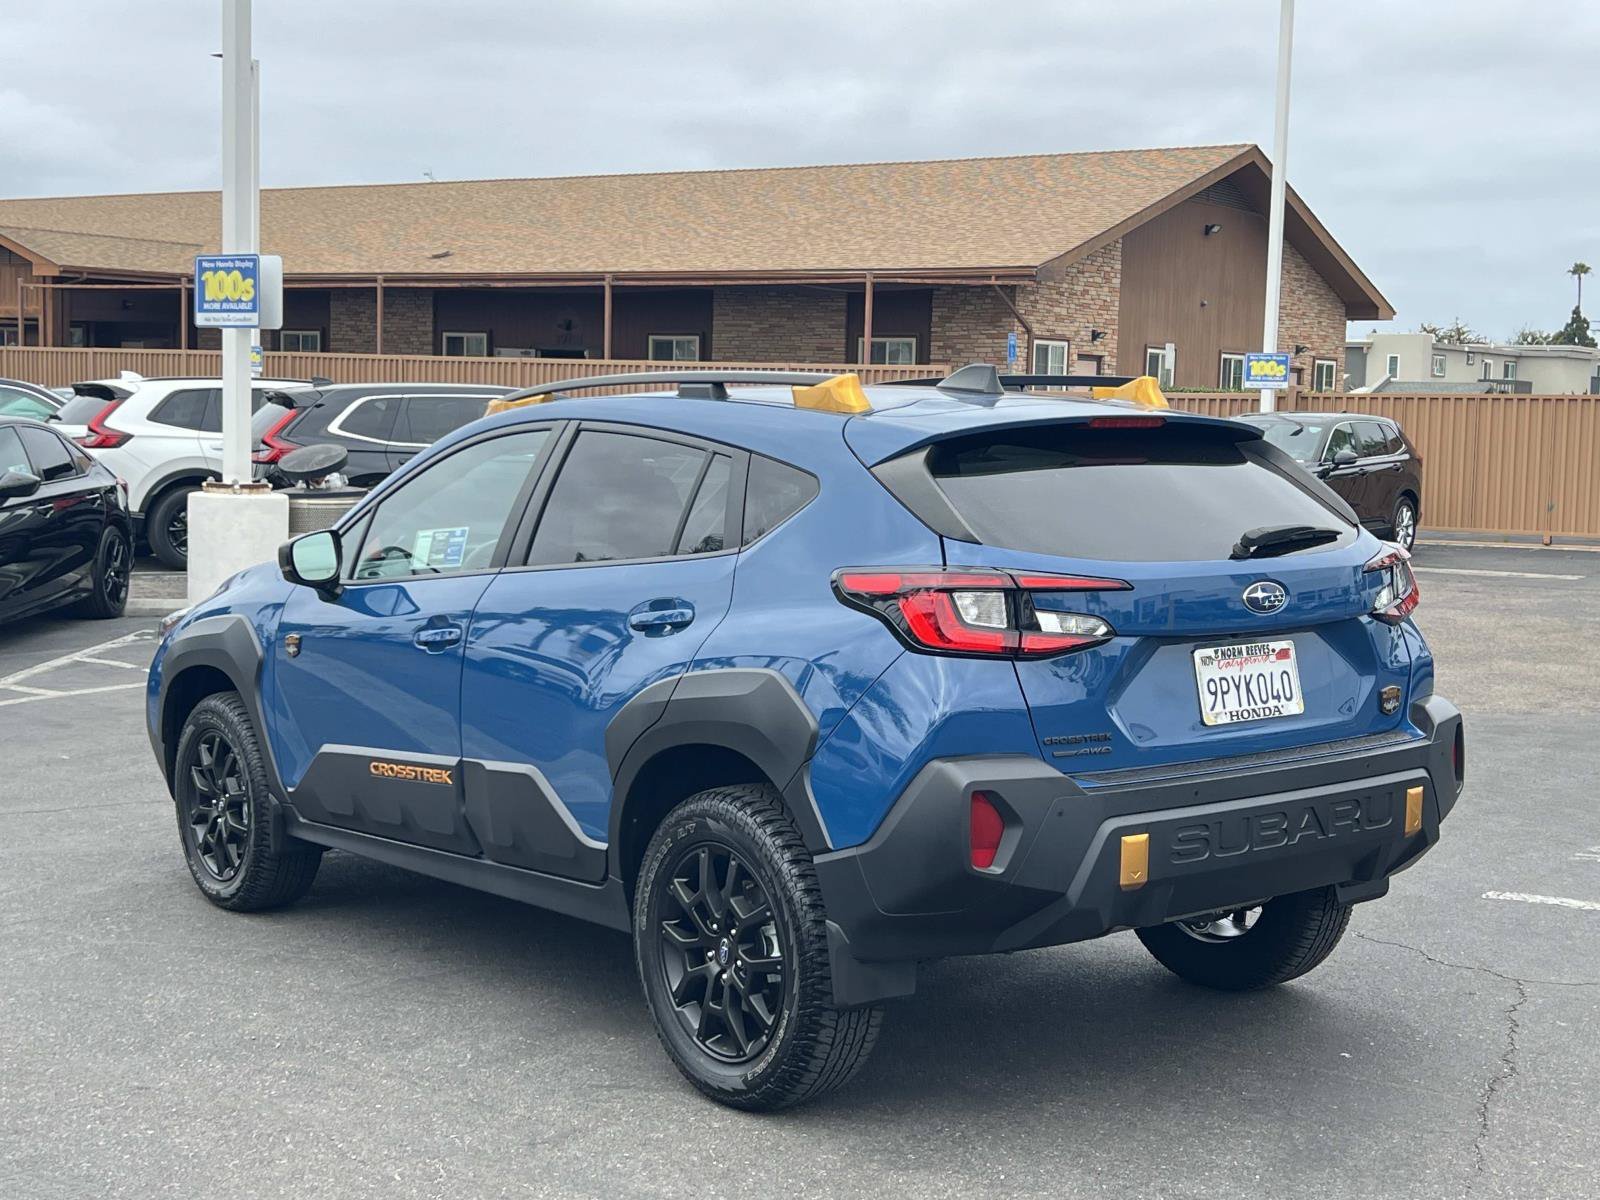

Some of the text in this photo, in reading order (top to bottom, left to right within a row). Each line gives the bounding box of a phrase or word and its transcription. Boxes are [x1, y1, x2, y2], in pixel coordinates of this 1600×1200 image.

[201, 270, 255, 302] 100s
[203, 302, 221, 310] MORE
[1249, 360, 1287, 377] 100s
[1220, 646, 1244, 660] NORM
[1245, 644, 1271, 657] REEVES
[1207, 670, 1293, 712] 9PYK040
[1229, 705, 1284, 721] HONDA
[1043, 732, 1113, 745] CROSSTREK
[370, 761, 453, 785] CROSSTREK
[1170, 791, 1395, 864] SUBARU
